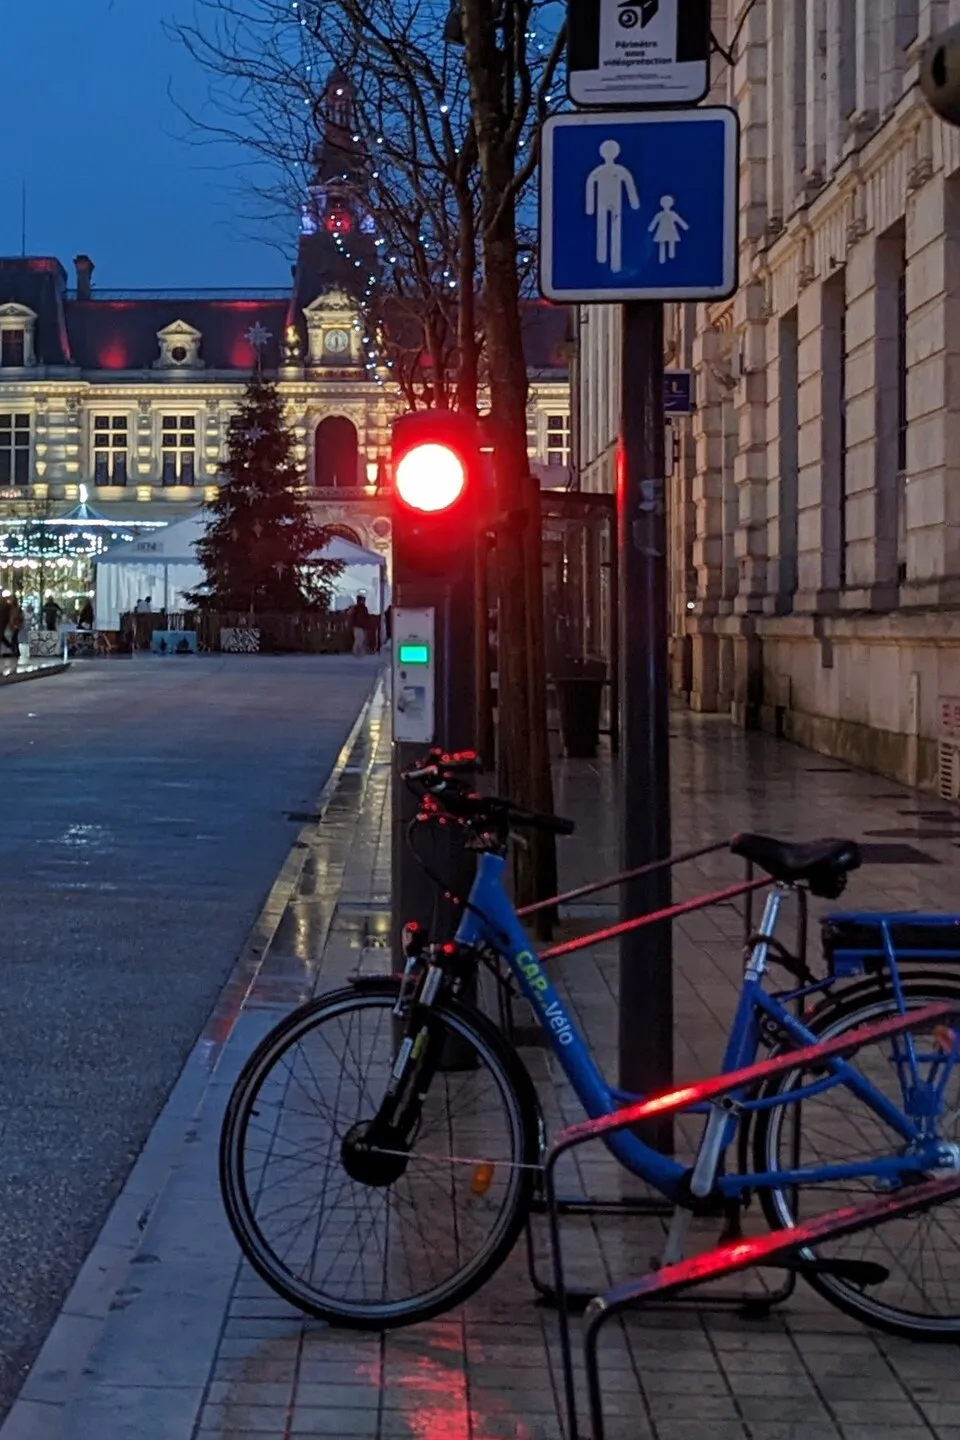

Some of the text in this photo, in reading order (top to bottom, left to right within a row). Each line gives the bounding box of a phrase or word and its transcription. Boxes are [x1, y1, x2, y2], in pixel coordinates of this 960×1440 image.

[615, 40, 658, 49] Périmètre
[515, 950, 548, 991] CAP
[545, 1001, 573, 1046] Vélo
